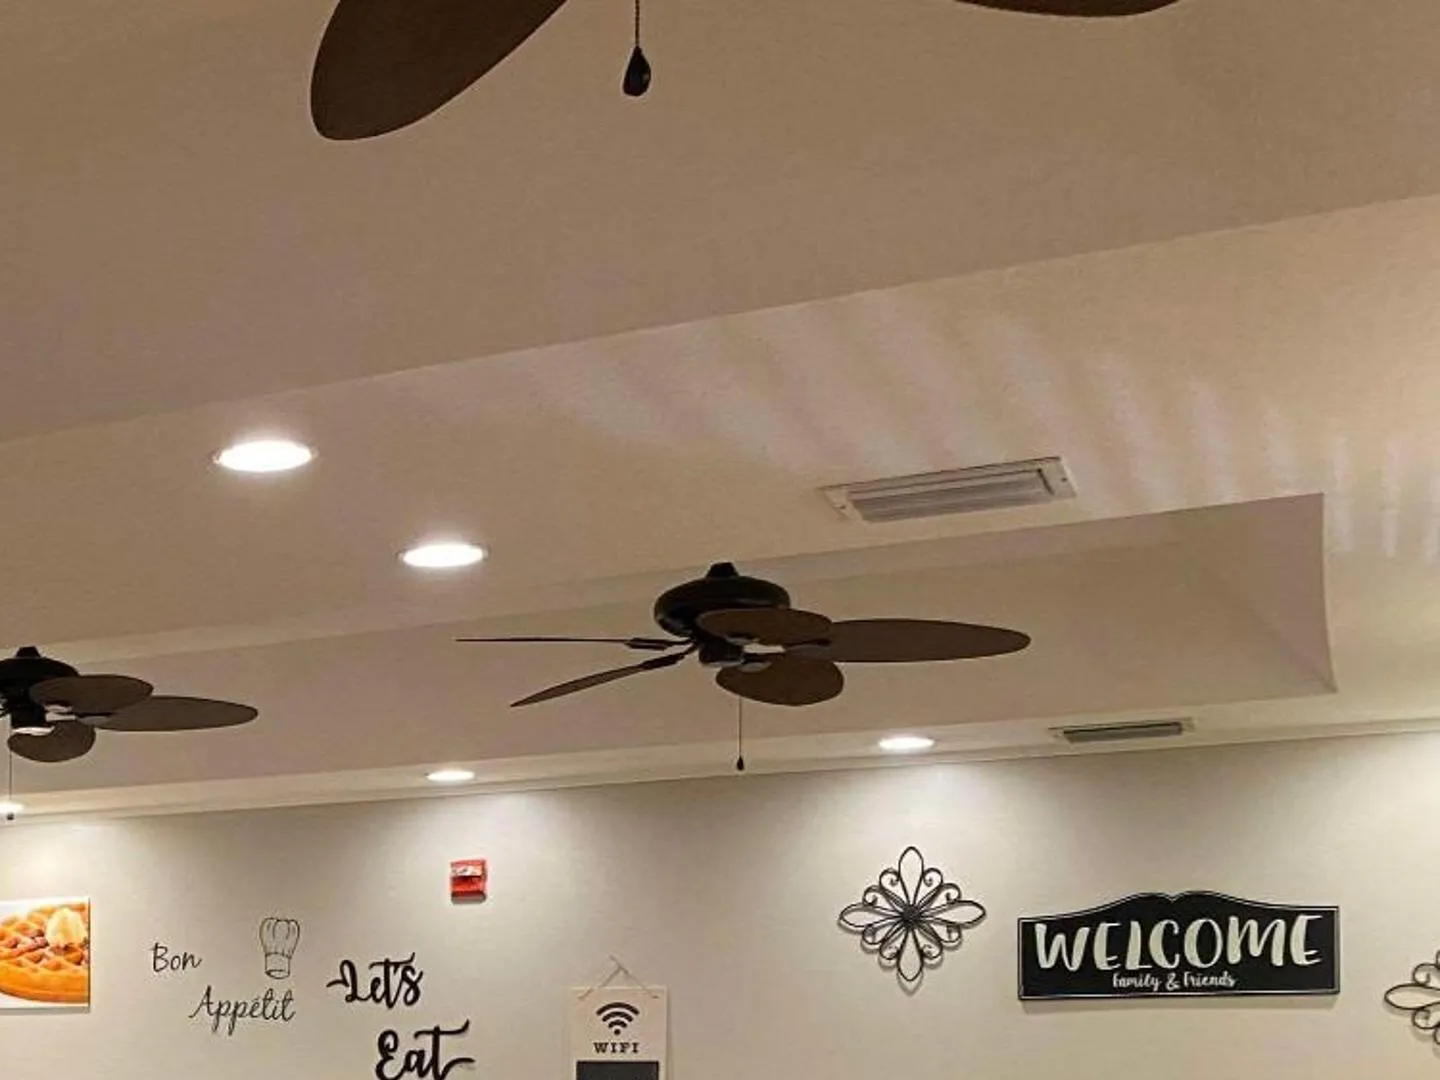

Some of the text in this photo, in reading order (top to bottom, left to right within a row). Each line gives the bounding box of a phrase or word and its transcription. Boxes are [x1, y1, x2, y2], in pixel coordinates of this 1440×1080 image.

[151, 942, 202, 973] Bon
[1034, 914, 1323, 972] WELCOME
[326, 951, 424, 1010] Let's
[1166, 972, 1180, 991] &
[593, 1042, 640, 1054] WIFI
